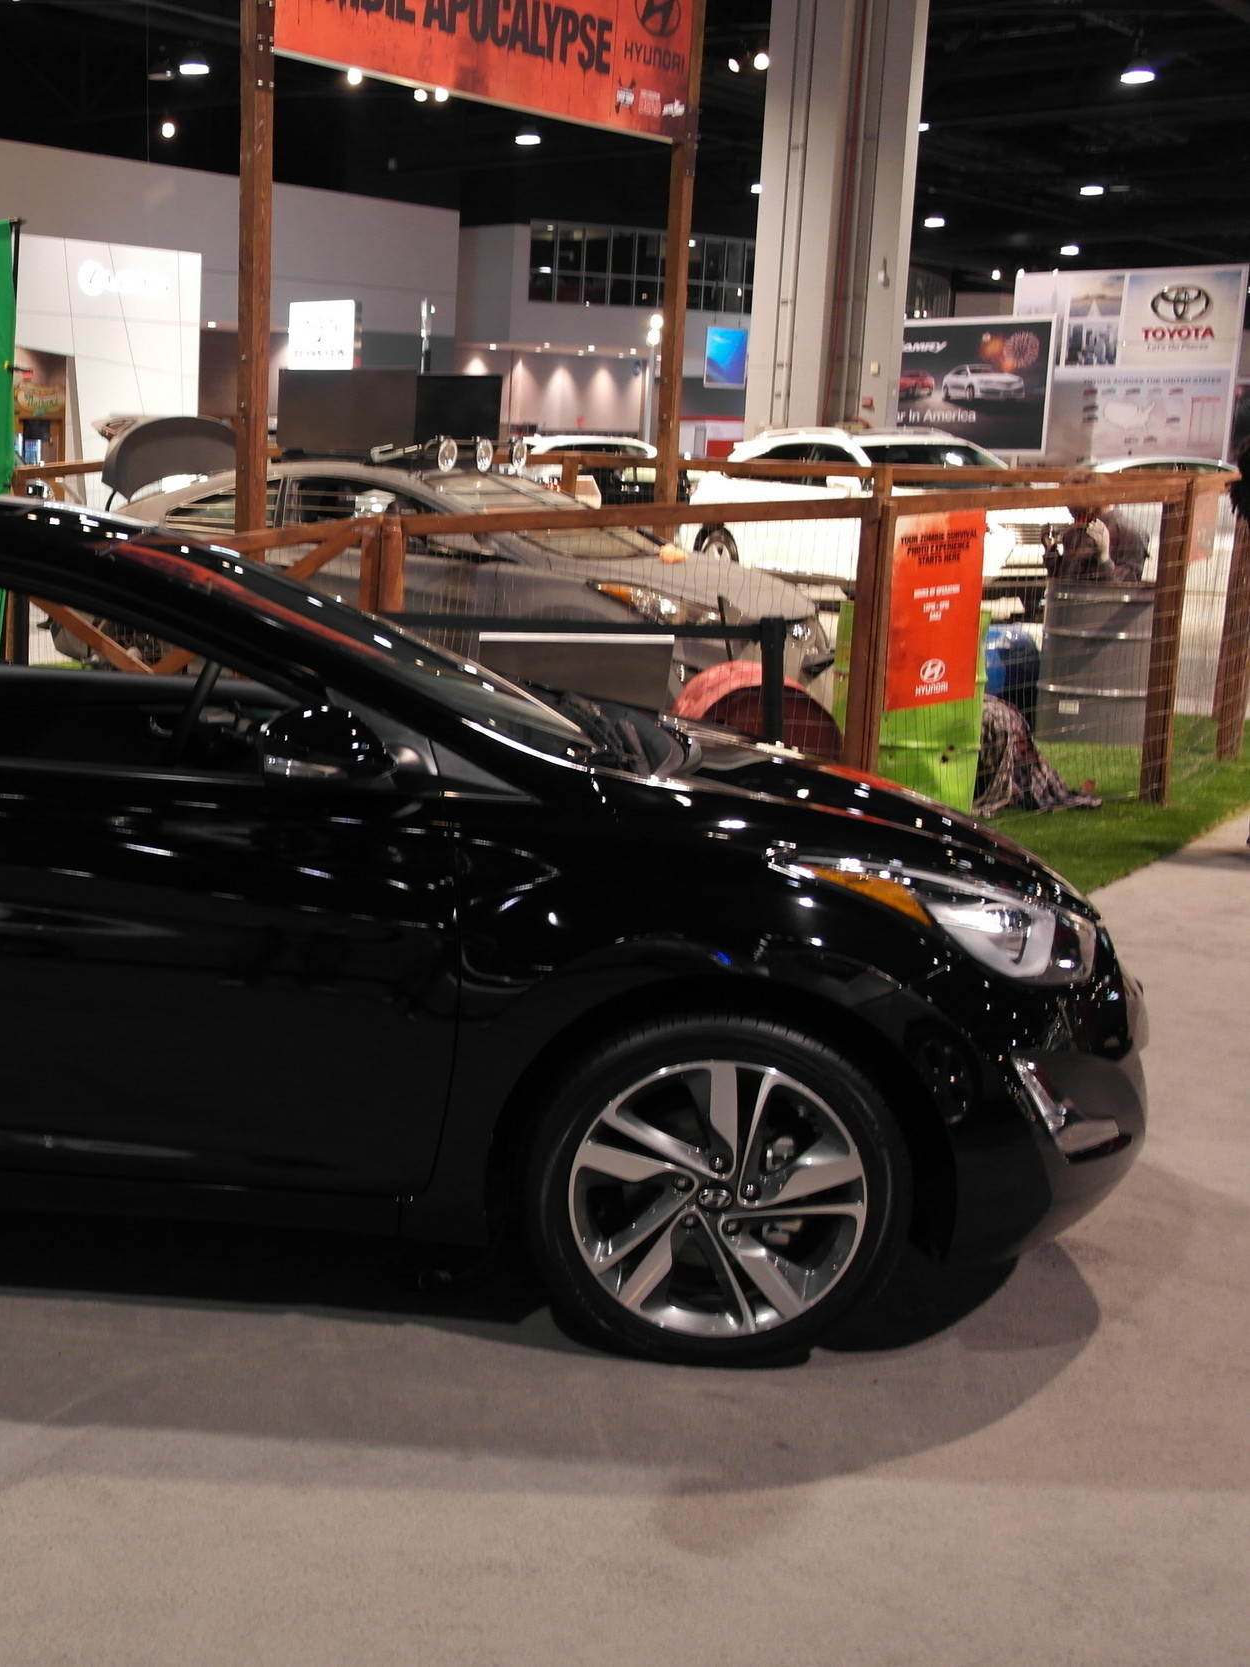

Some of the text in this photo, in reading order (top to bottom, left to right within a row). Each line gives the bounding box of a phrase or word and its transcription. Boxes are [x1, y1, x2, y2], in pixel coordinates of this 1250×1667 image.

[423, 0, 613, 75] APOCALYPSE
[624, 40, 685, 74] HYUNDAI
[1142, 326, 1215, 341] TOYOTA
[923, 407, 977, 422] America
[915, 681, 948, 697] HYUNDAI
